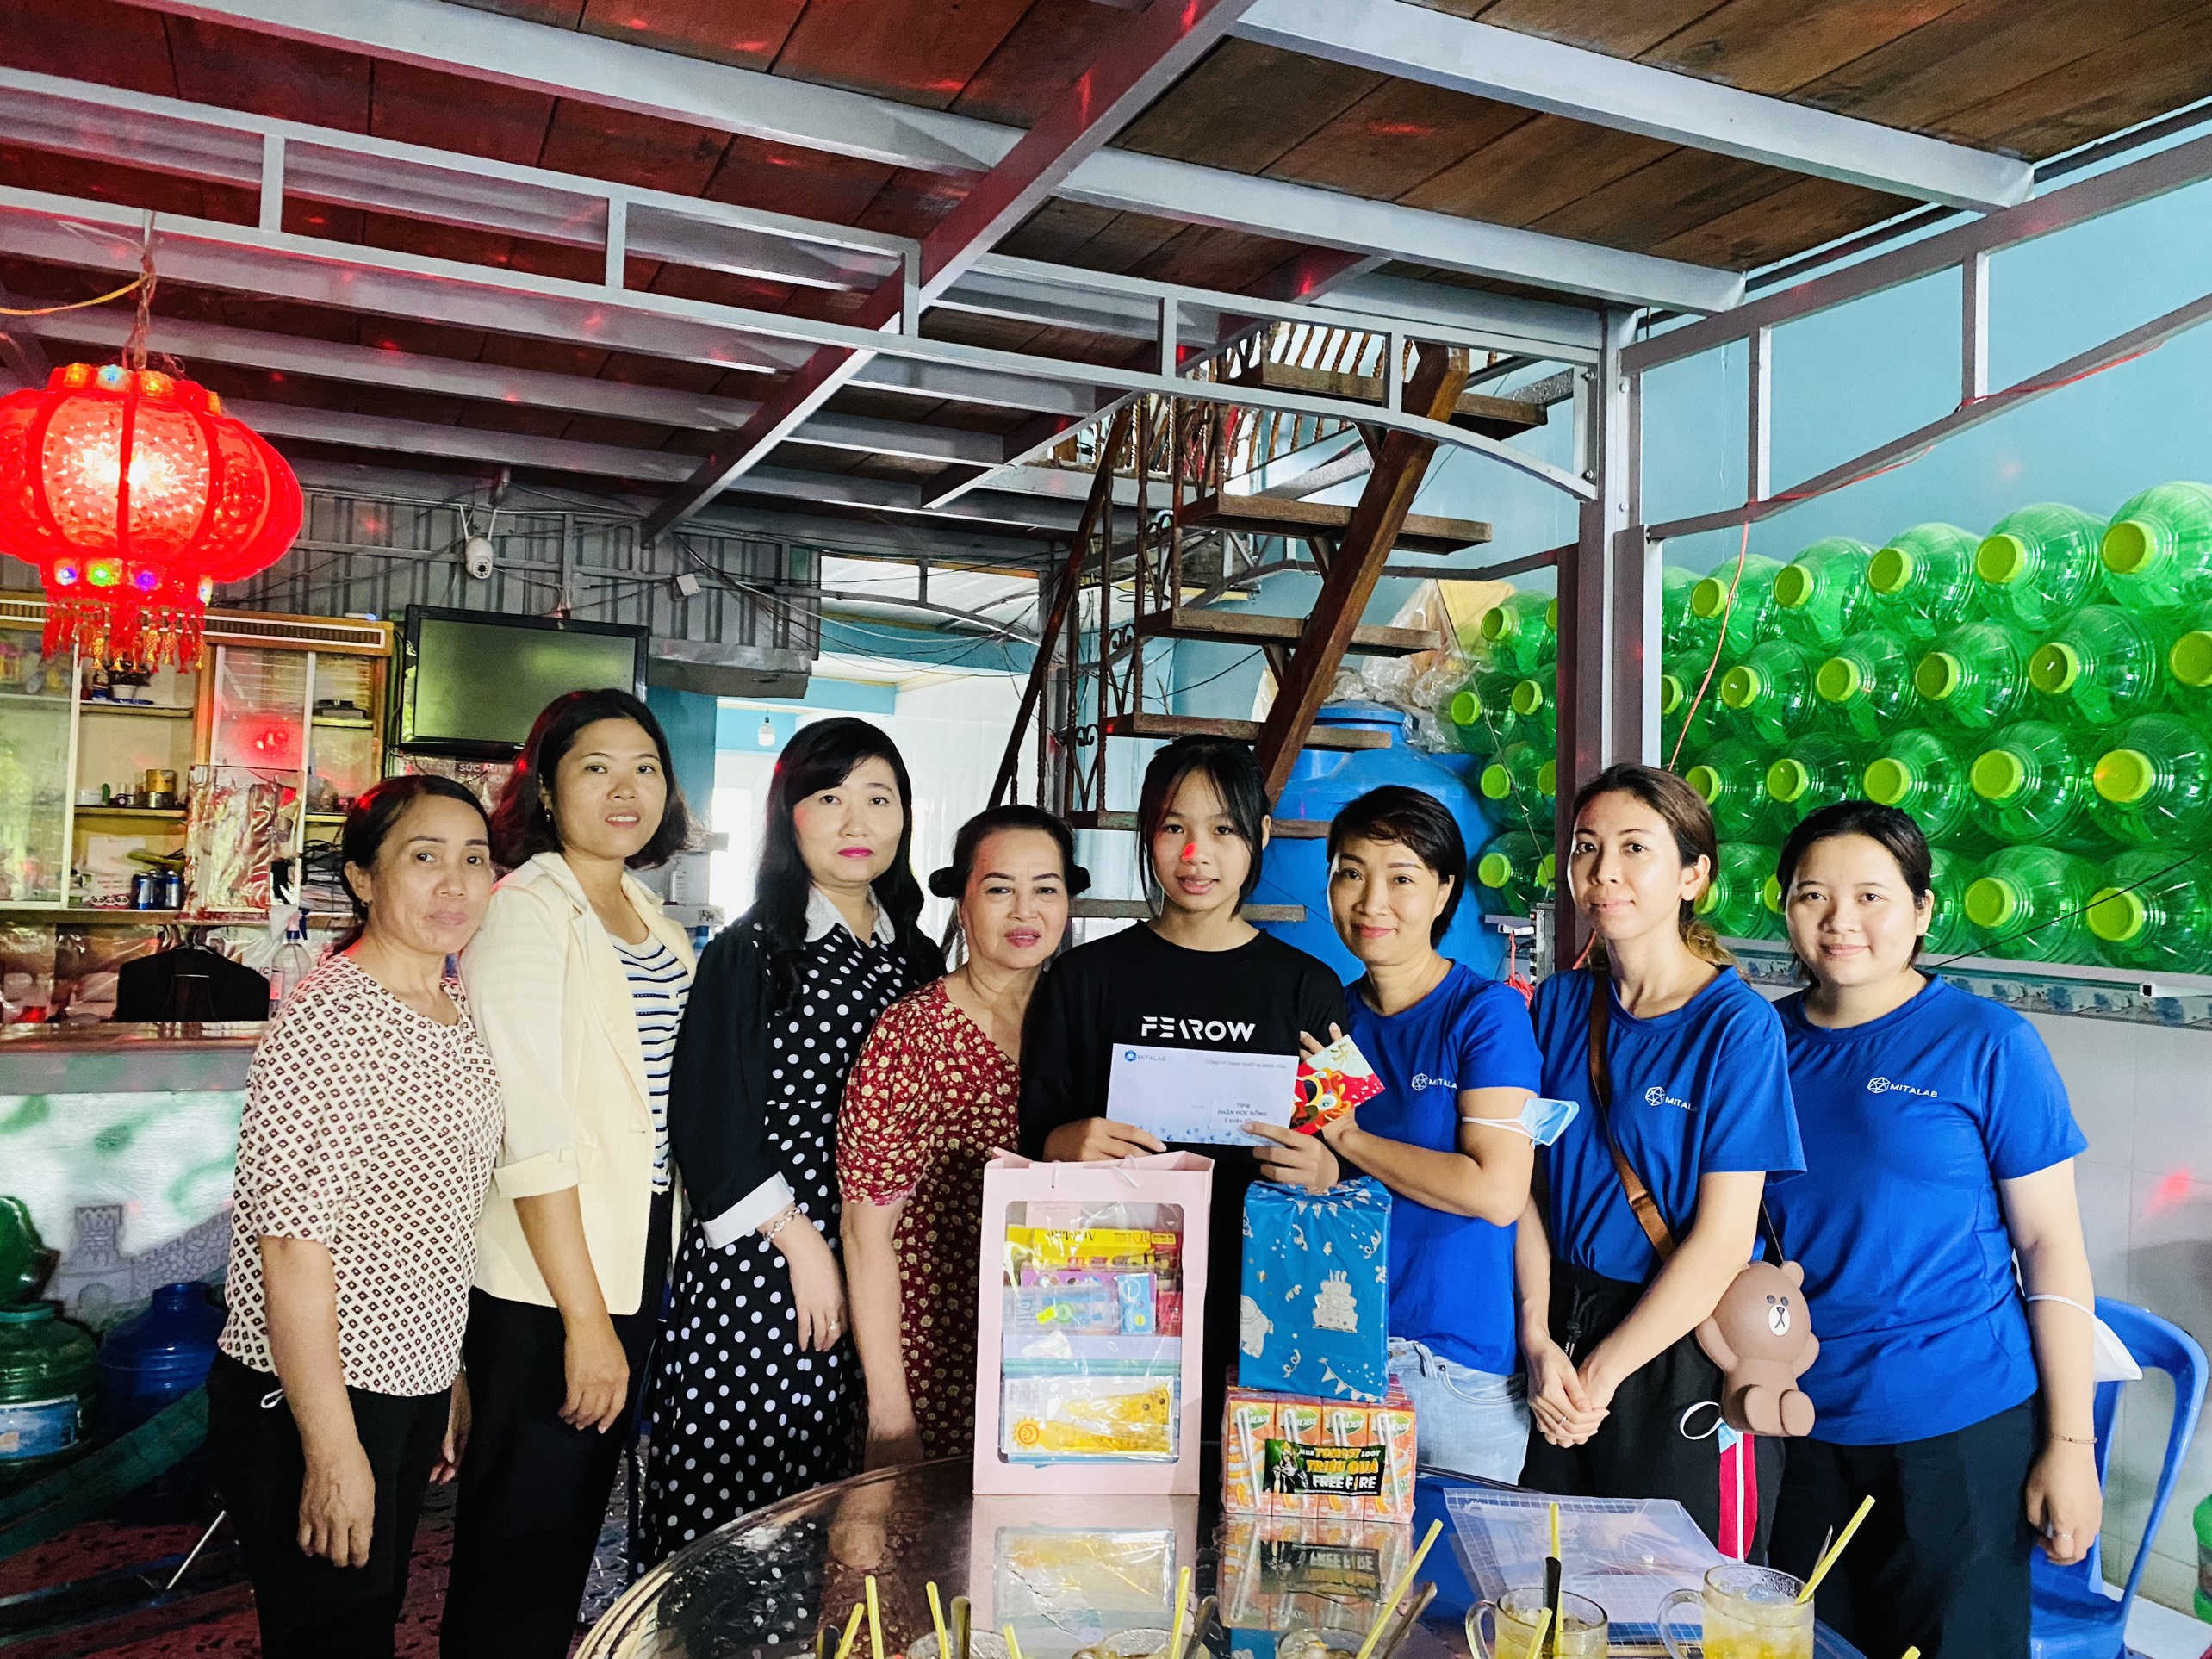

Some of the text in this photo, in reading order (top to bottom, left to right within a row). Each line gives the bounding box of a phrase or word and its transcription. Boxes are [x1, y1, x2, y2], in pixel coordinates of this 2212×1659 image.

[1890, 1083, 1938, 1098] MITALAB
[1314, 1447, 1362, 1458] YOMOST
[1312, 1474, 1345, 1489] FREE
[1345, 1476, 1377, 1491] FIRE
